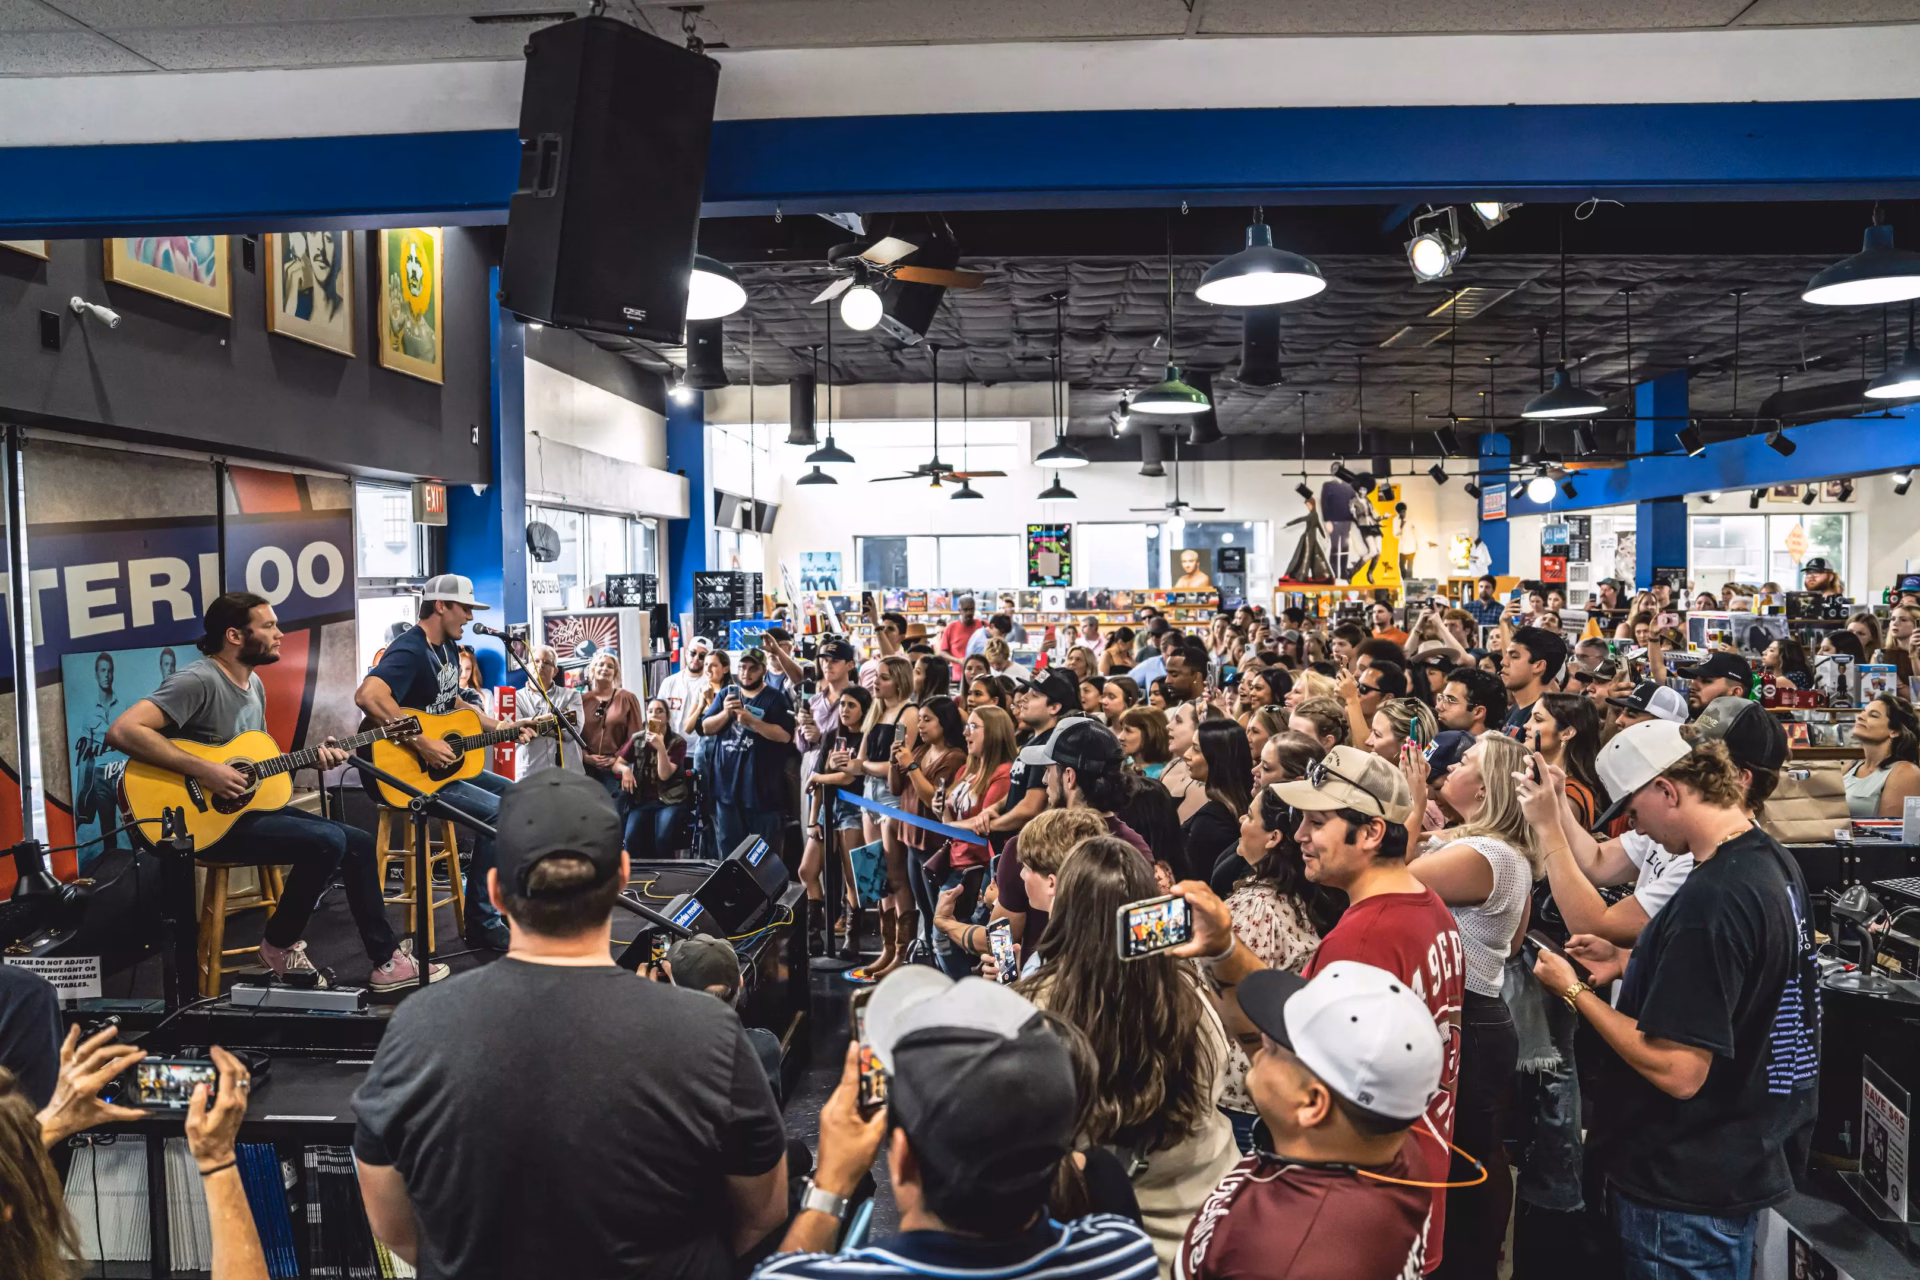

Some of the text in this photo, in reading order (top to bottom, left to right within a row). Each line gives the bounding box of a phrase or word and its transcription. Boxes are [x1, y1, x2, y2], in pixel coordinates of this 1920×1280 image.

[425, 485, 444, 513] EXIT
[532, 580, 559, 595] POSTERS
[501, 694, 514, 761] EXT
[64, 958, 93, 966] ADJUST
[27, 966, 83, 974] UNTERWEIGHT
[47, 973, 97, 981] MECHANISMS
[54, 981, 90, 989] NTABLES.
[1864, 1083, 1886, 1112] SAVE
[1888, 1106, 1905, 1131] $65
